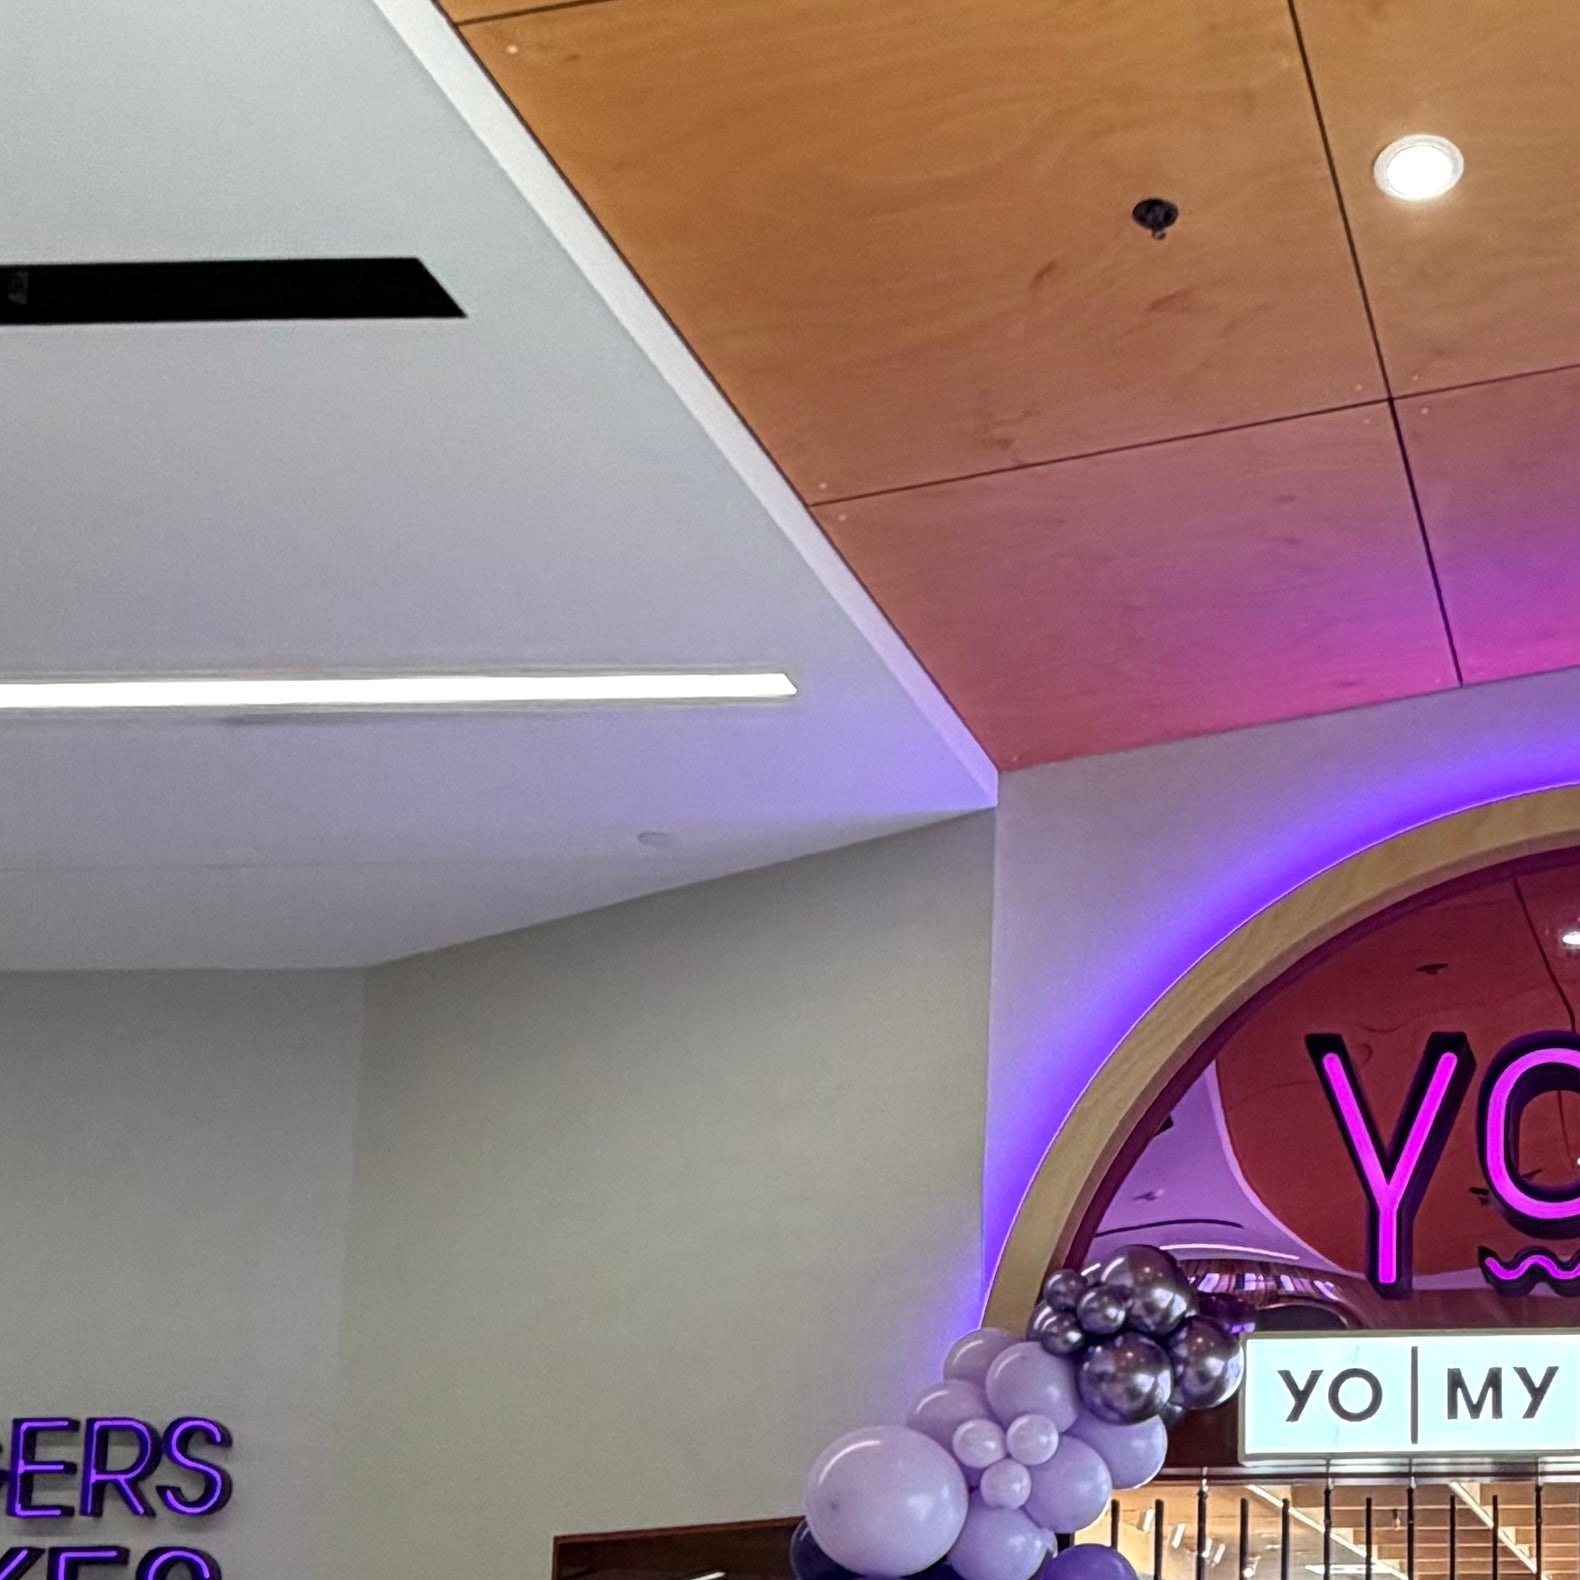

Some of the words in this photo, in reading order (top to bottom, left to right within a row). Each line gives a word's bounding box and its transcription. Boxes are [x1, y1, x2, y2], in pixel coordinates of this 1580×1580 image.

[1278, 1367, 1383, 1424] YO
[1446, 1365, 1560, 1421] MY
[0, 1416, 233, 1519] ERS
